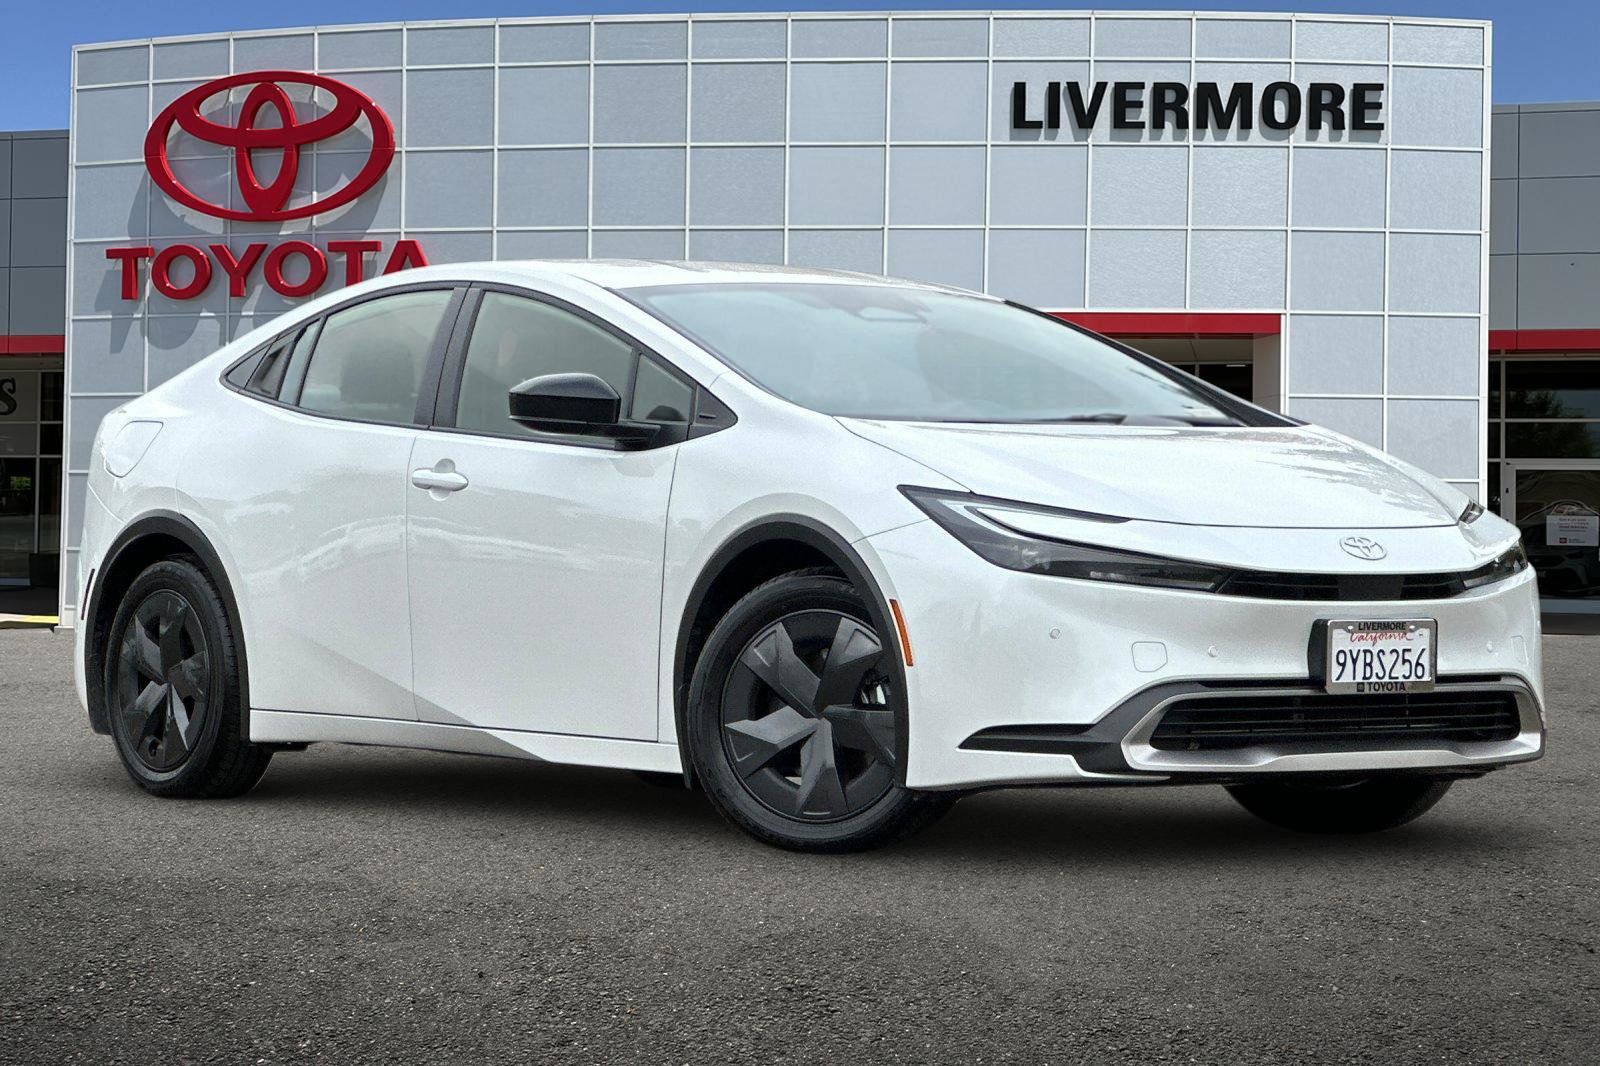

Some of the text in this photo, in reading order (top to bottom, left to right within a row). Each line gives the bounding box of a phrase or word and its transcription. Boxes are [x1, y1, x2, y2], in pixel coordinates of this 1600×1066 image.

[1012, 81, 1385, 131] LIVERMORE
[1358, 621, 1407, 631] LIVERMORE
[1335, 648, 1426, 681] 9YBS256
[1367, 682, 1407, 692] TOYOTA
